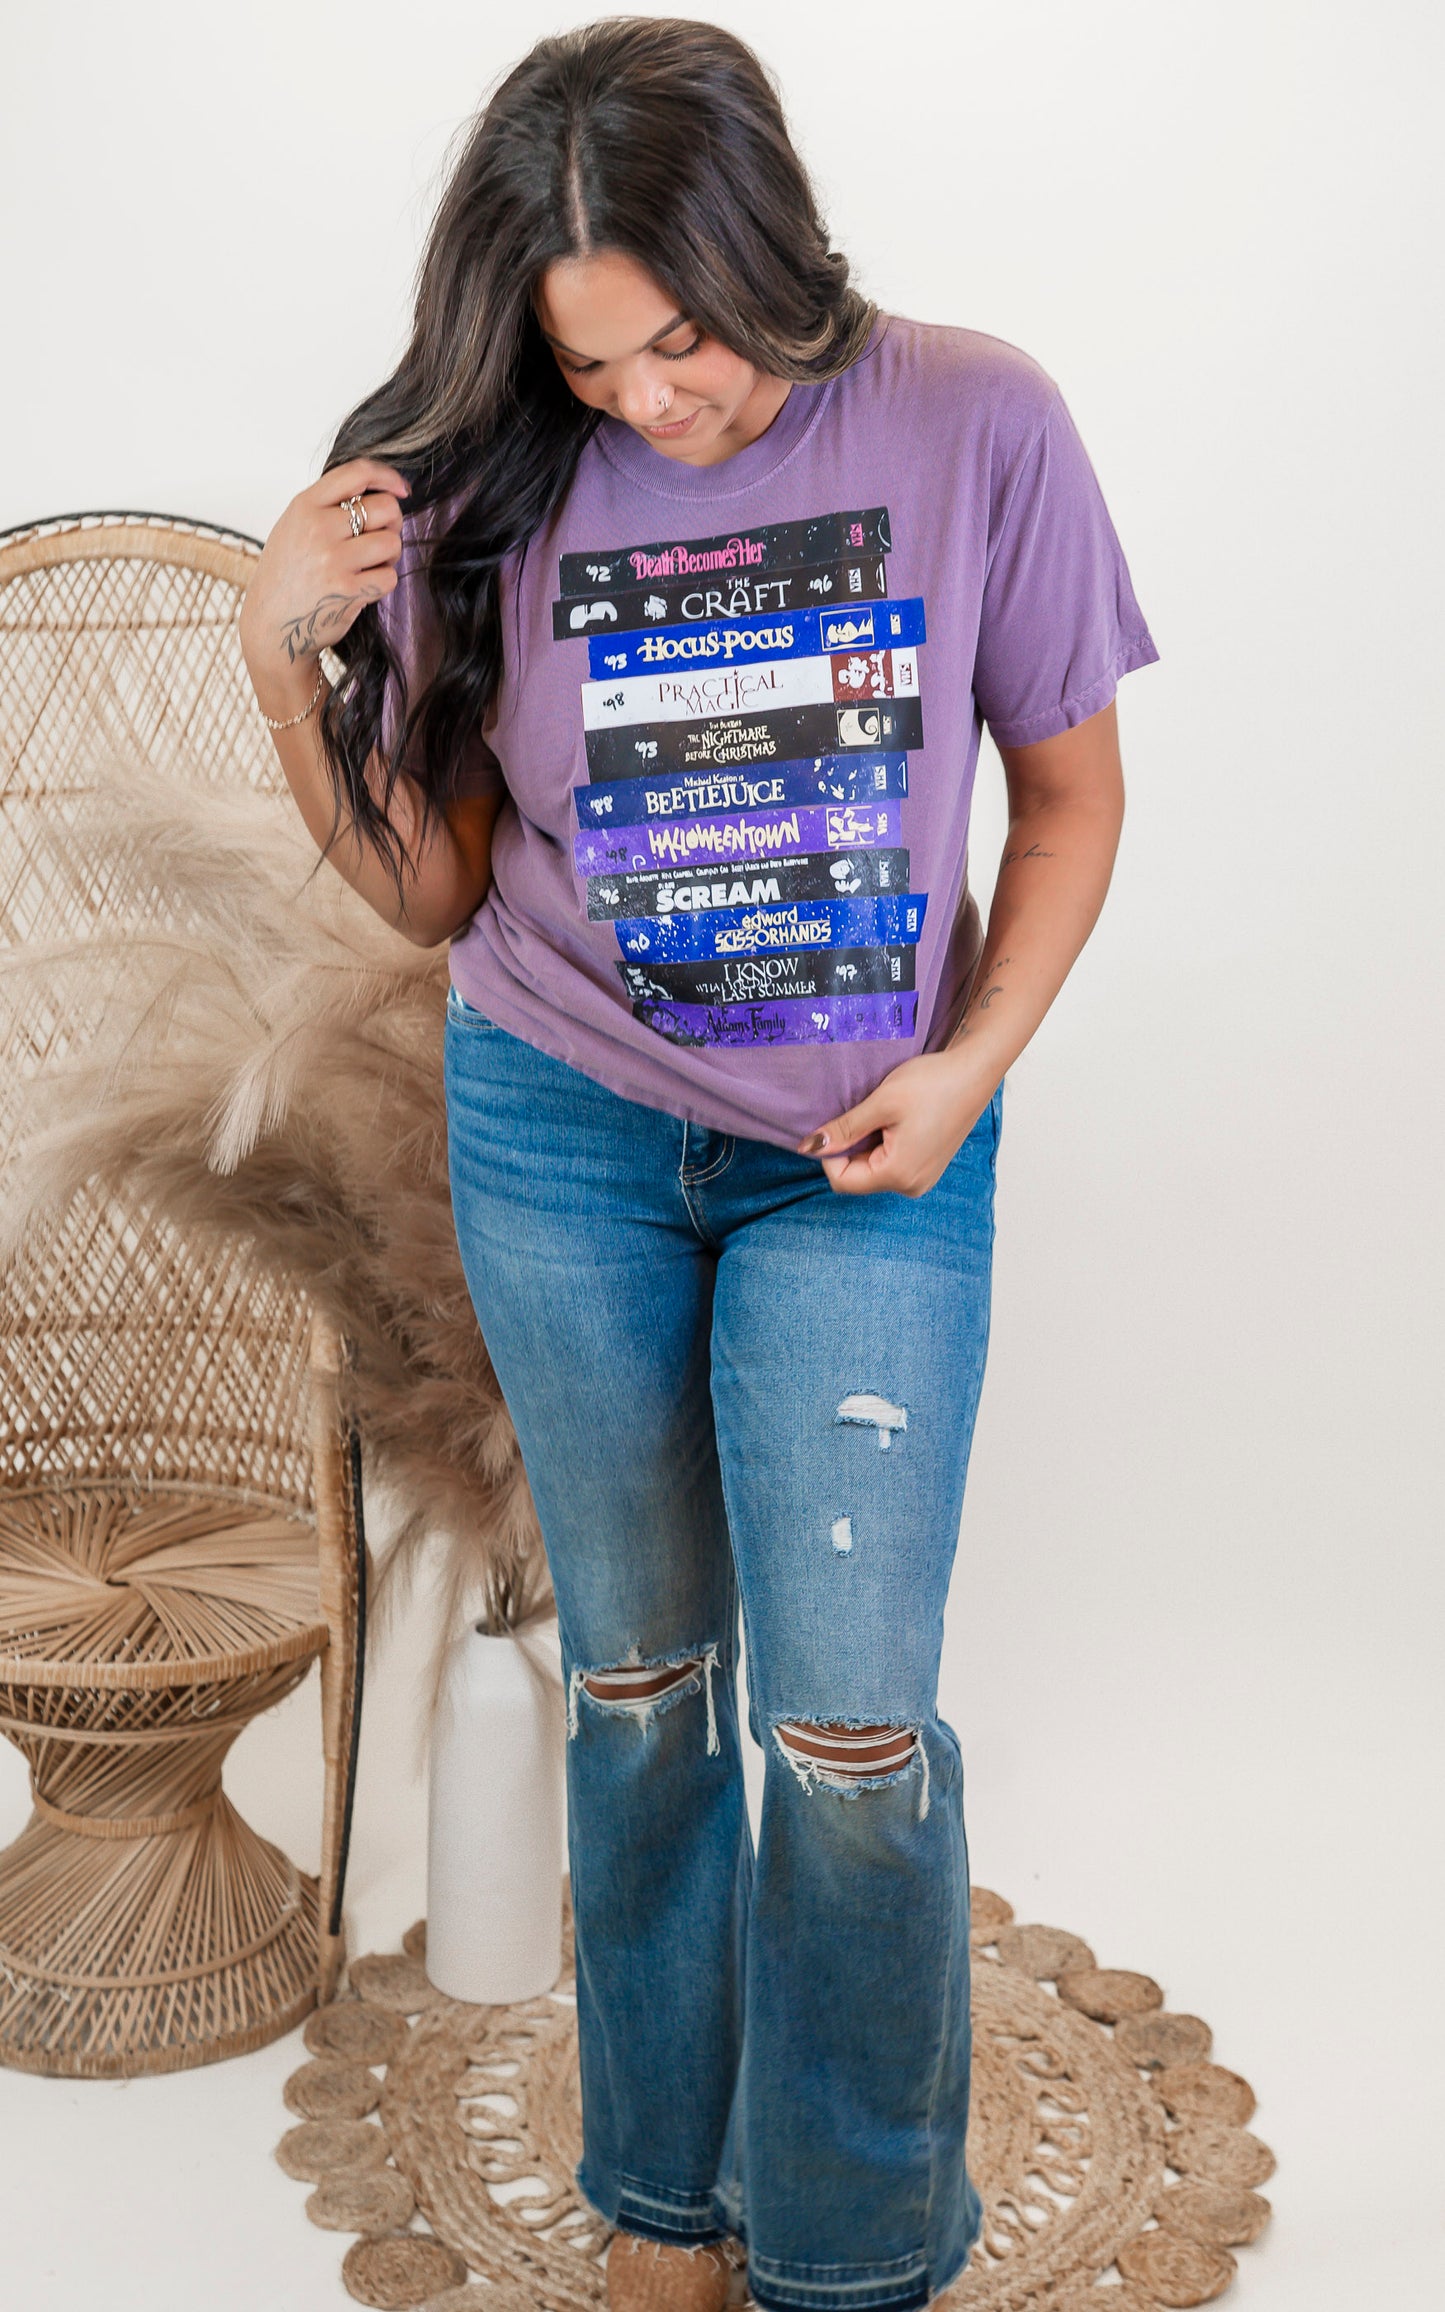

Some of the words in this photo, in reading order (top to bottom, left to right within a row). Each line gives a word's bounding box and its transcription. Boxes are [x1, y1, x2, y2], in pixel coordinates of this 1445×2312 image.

[630, 549, 674, 580] Death
[671, 546, 737, 574] Becomes
[727, 537, 764, 566] Her
[681, 578, 792, 619] CRAFT
[726, 577, 750, 590] THE
[659, 669, 783, 702] PRACTICAL
[685, 750, 711, 762] BEFORE
[713, 741, 777, 763] CHRISTMAS
[701, 725, 771, 750] NIGHTMARE
[645, 778, 785, 815] BEETLEJUICE
[648, 813, 801, 863] HALLOWEENTOWN
[656, 878, 781, 913] SCREAM
[742, 906, 799, 930] edward
[715, 922, 832, 953] SCISSORHANDS
[736, 957, 799, 981] KNOW
[722, 988, 754, 1002] LAST
[758, 980, 816, 998] SUMMER
[744, 1005, 785, 1041] Family
